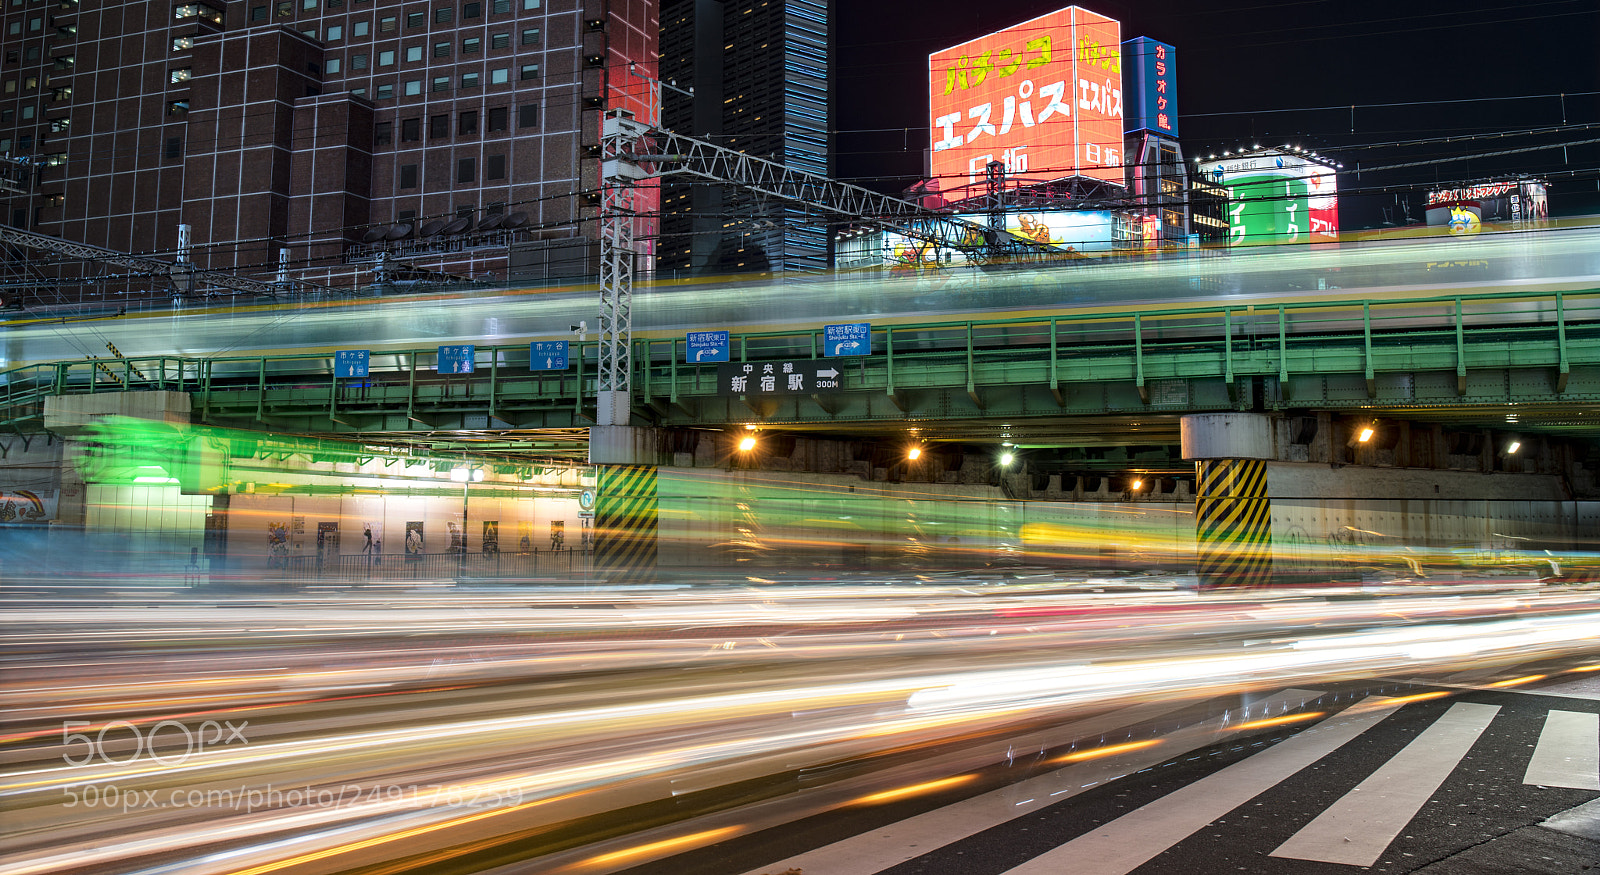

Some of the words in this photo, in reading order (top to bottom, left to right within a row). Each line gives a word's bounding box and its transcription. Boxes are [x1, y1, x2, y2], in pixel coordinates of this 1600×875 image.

[943, 35, 1052, 96] パチンコ
[1079, 34, 1121, 74] パチンコ
[934, 79, 1070, 152] エスパス
[1079, 78, 1122, 117] エスパス
[731, 373, 804, 393] 新宿駅
[743, 362, 794, 375] 中央線
[816, 380, 839, 388] 300M
